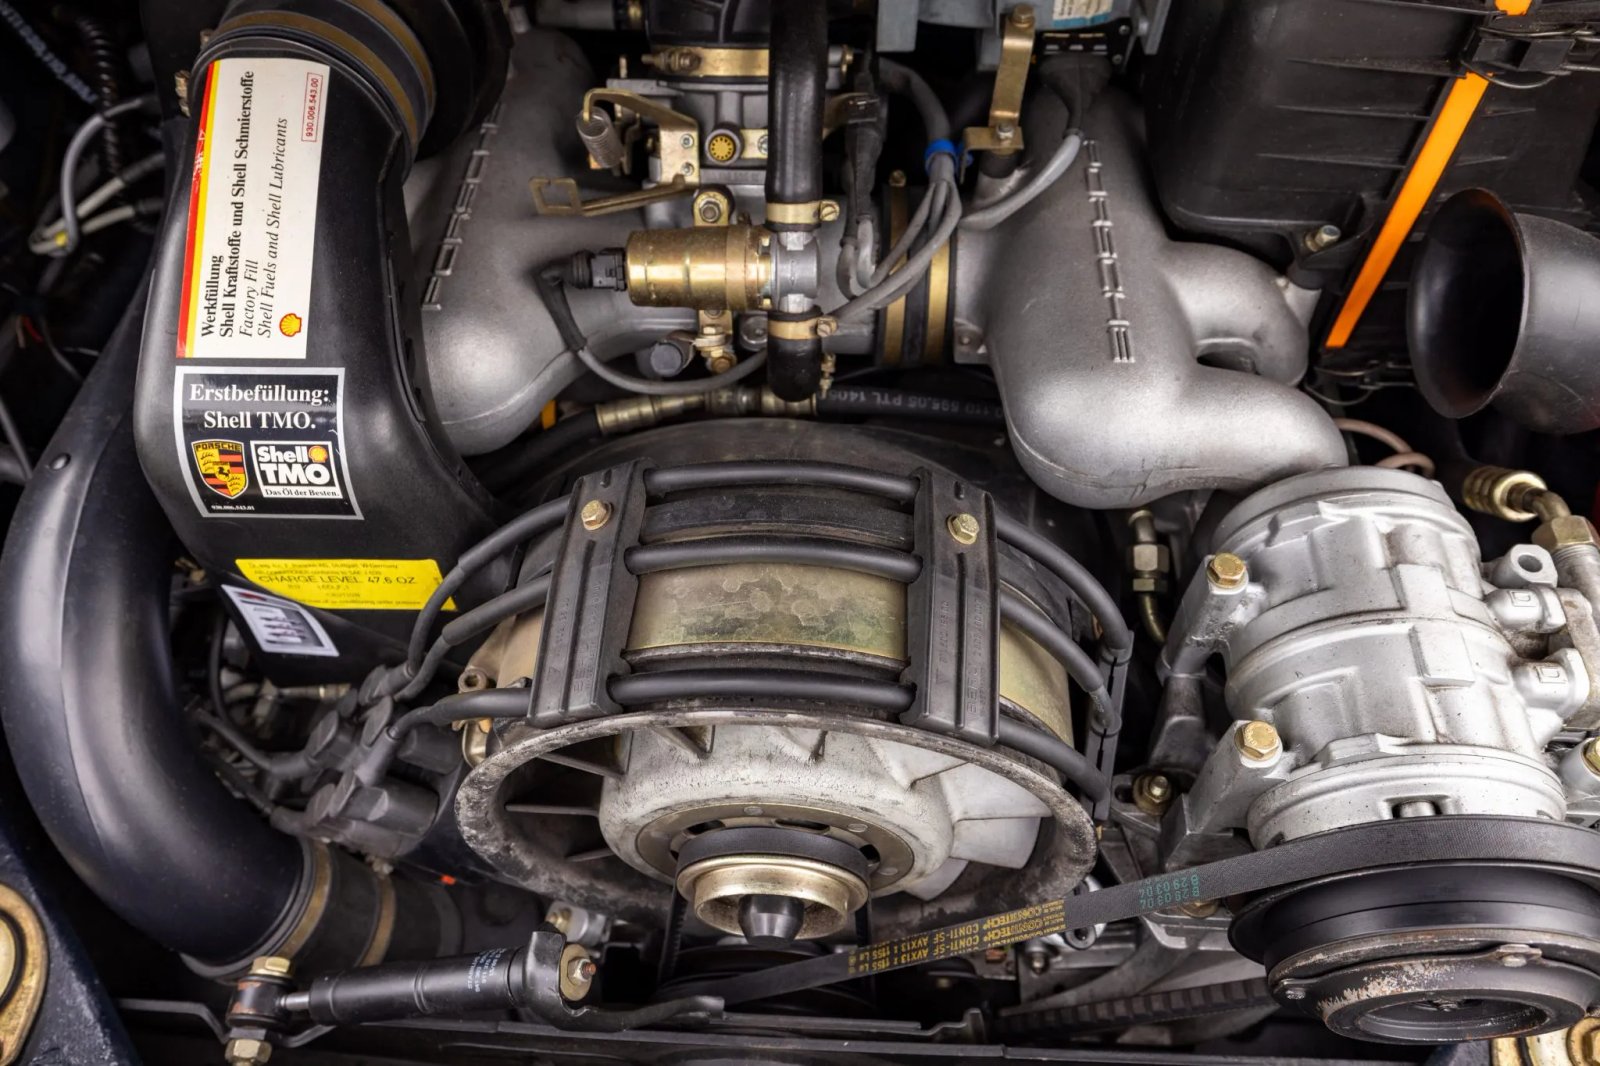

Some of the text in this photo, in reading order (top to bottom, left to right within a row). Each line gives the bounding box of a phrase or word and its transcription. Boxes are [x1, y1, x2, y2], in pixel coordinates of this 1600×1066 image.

[306, 78, 319, 137] 930.006.543.00
[219, 71, 254, 337] Shell Kraftstoffe und Shell Schmierstoffe
[258, 117, 288, 338] Shell Fuels and Shell Lubricants
[201, 255, 224, 337] Werkfüllung
[239, 259, 259, 337] Factory Fill
[190, 383, 330, 406] Erstbefüllung:
[204, 410, 316, 429] Shell TMO.
[194, 442, 242, 452] PORSCHE
[258, 445, 308, 463] Shell
[260, 463, 331, 485] TMO
[265, 487, 340, 497] Das Öl der Besten.
[258, 575, 317, 583] CHARGE
[319, 575, 362, 583] LEVEL
[396, 575, 418, 584] OZ
[901, 936, 929, 951] AVX13
[933, 923, 979, 944] CONTI-SF
[933, 934, 980, 956] CONTI-SF
[901, 948, 929, 964] AVX13
